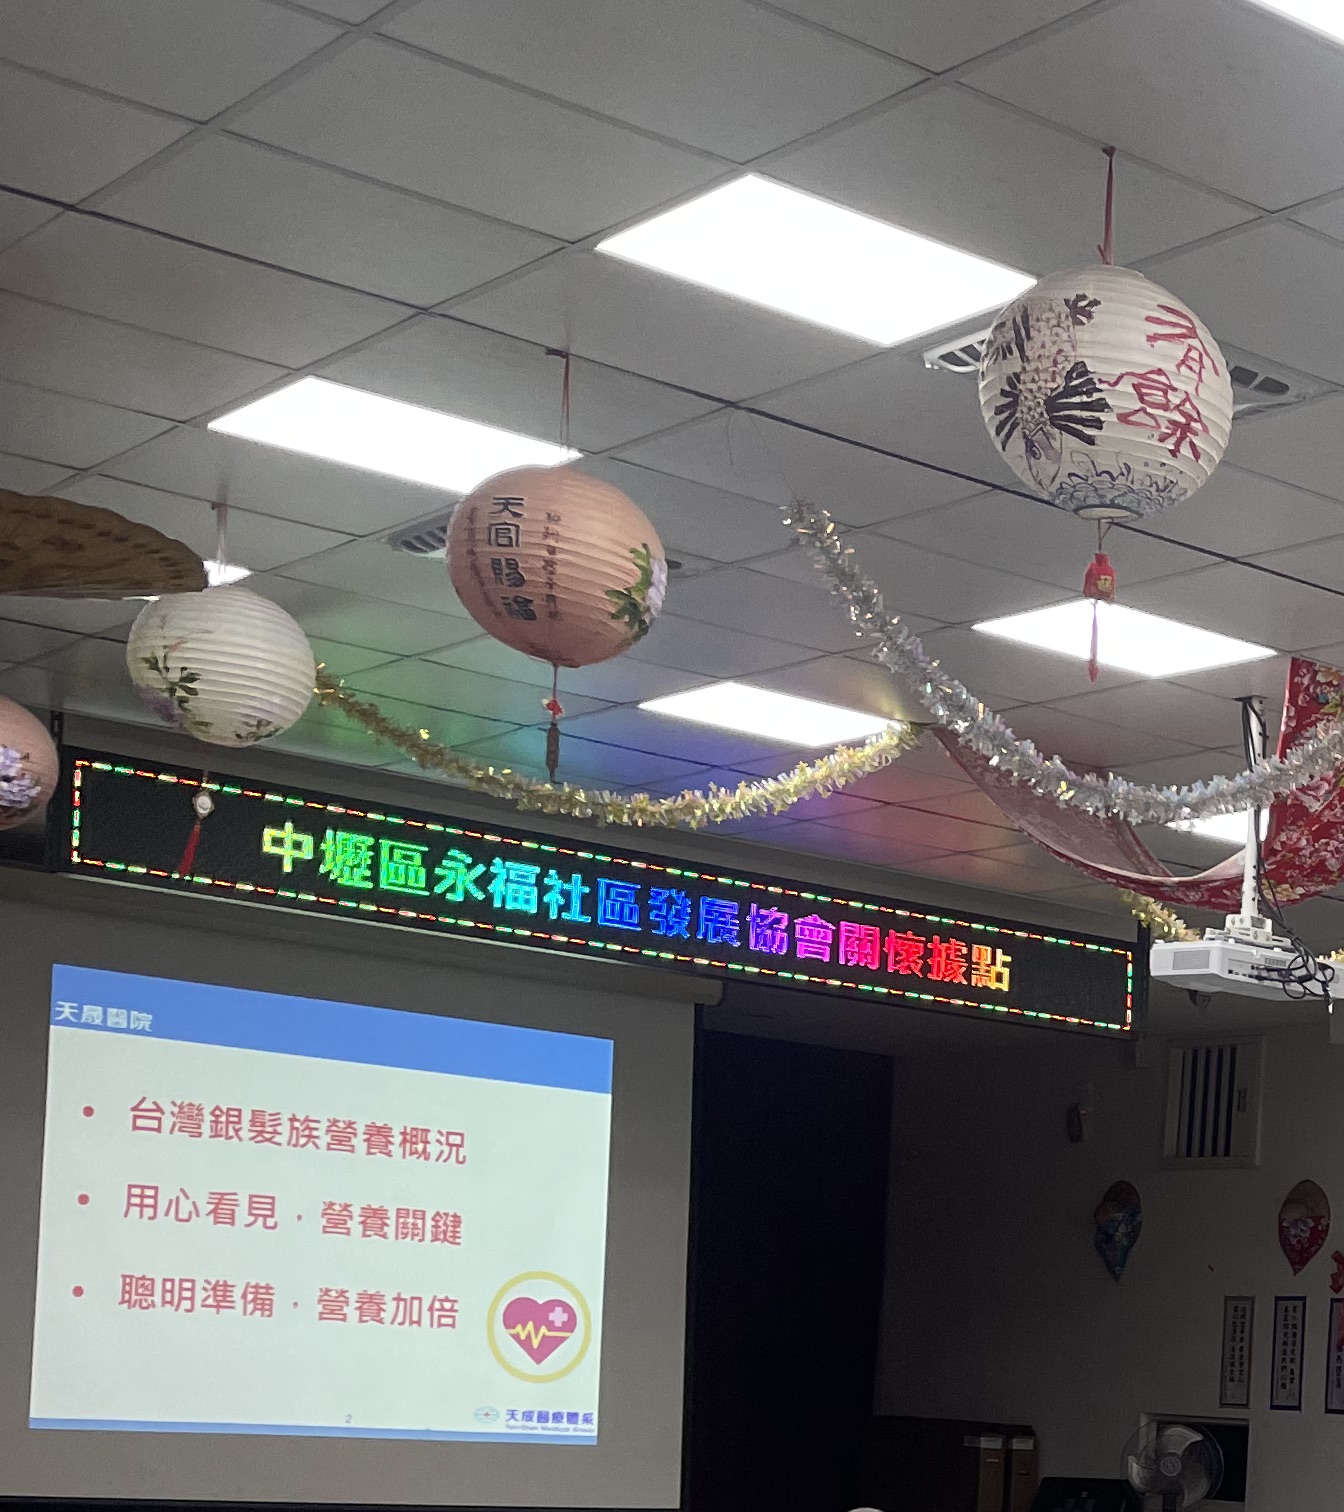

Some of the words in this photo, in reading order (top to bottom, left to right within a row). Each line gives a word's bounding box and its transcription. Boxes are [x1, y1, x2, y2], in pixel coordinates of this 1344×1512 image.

[261, 820, 1012, 993] 中壢區永福社區發展協會關懷據點
[54, 1001, 154, 1033] 天晟醫院
[128, 1097, 468, 1165] 台灣銀髮族營養概況
